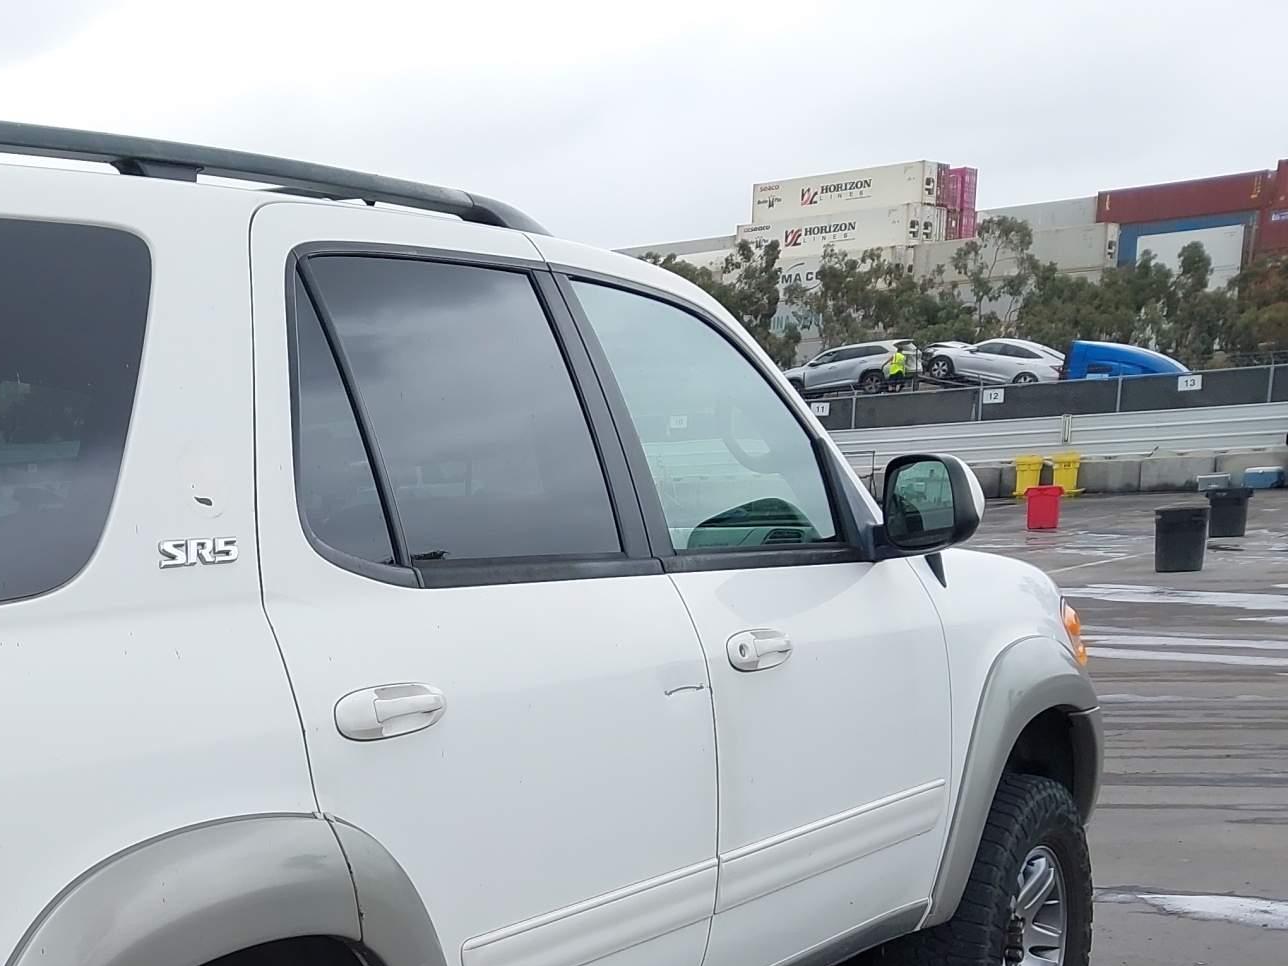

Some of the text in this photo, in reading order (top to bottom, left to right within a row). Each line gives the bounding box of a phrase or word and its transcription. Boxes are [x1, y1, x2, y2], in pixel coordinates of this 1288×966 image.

[820, 179, 873, 195] HORIZON
[819, 190, 864, 201] LINES
[804, 222, 856, 237] HORIZON
[803, 233, 849, 244] LINES
[779, 272, 802, 284] MA
[1185, 379, 1196, 387] 13
[989, 392, 999, 401] 12
[158, 536, 239, 569] SR5
